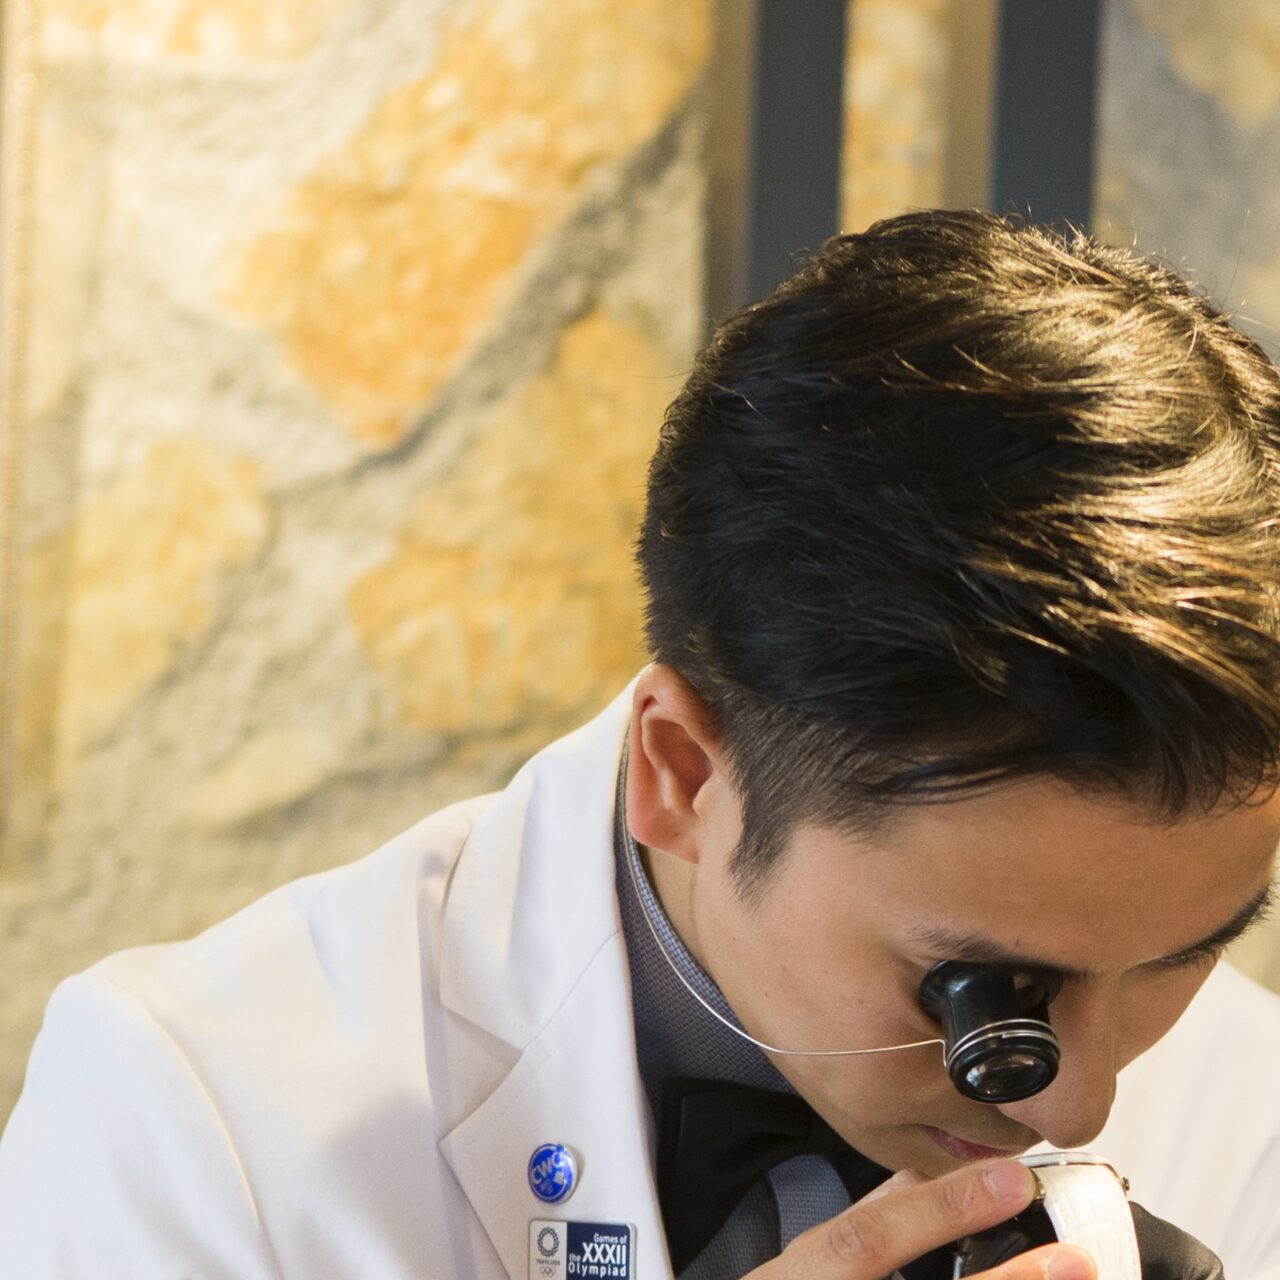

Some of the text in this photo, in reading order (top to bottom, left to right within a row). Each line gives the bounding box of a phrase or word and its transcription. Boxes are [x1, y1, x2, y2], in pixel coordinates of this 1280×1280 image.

[594, 1232, 627, 1244] Games of
[569, 1252, 581, 1262] the
[582, 1242, 626, 1265] XXXII
[568, 1262, 626, 1278] Olympiad
